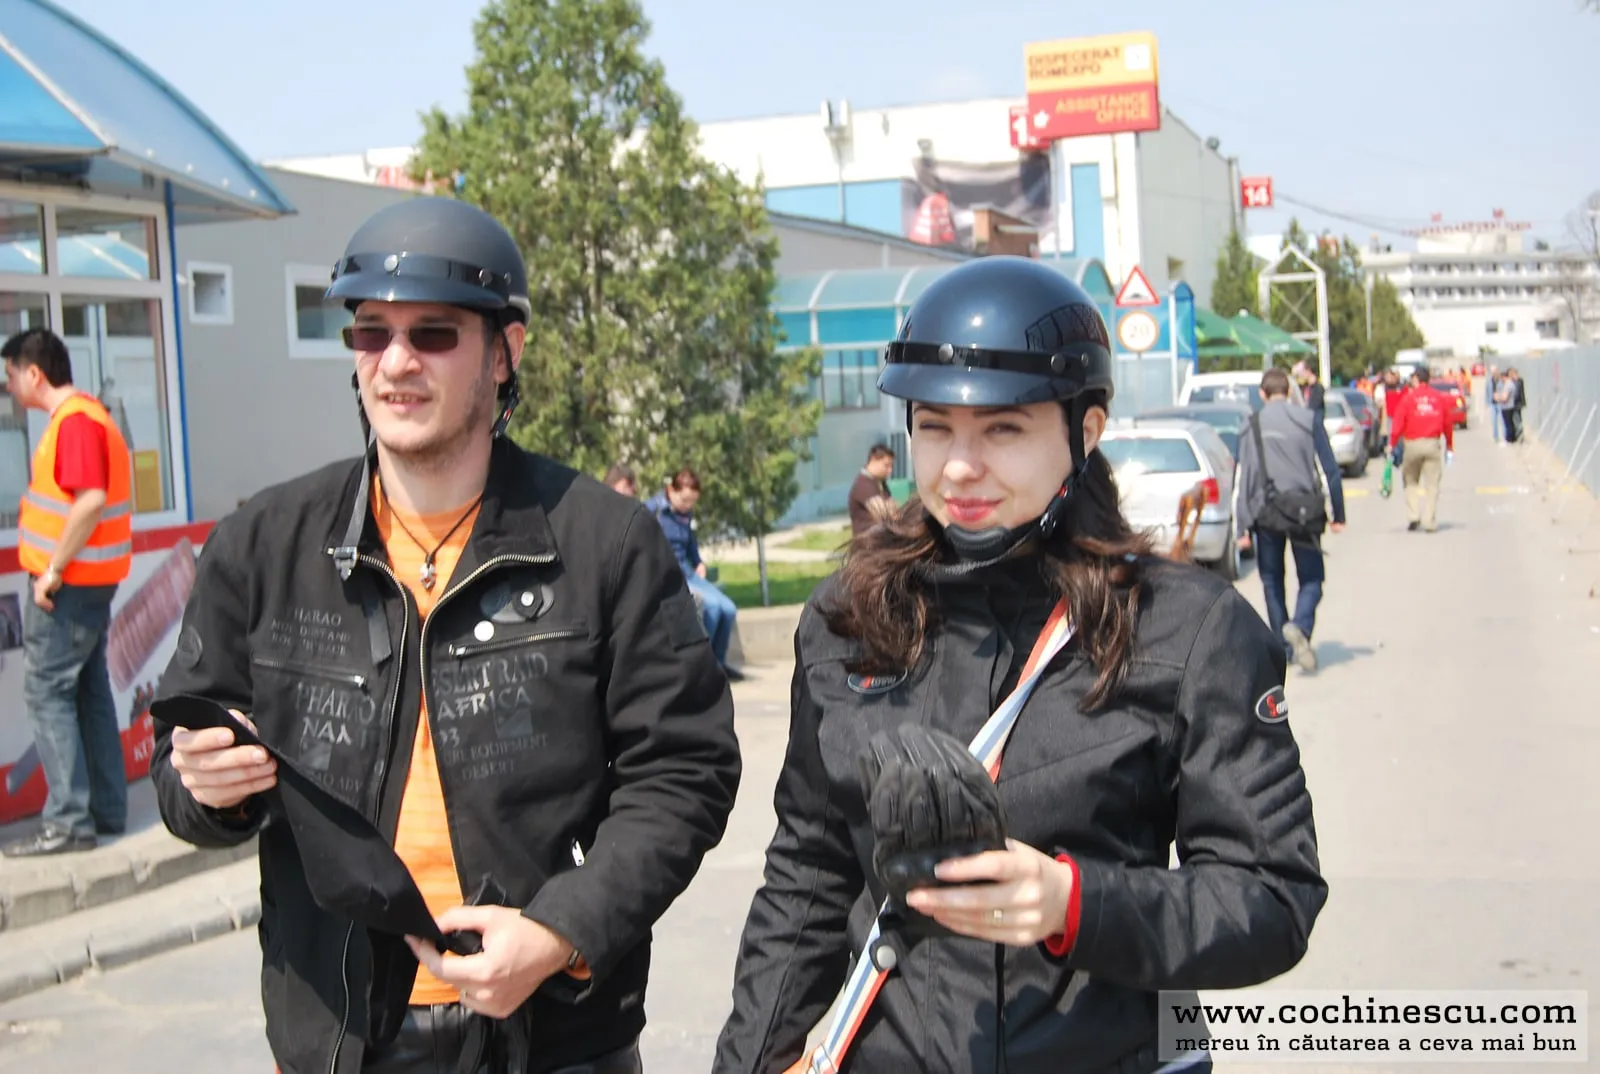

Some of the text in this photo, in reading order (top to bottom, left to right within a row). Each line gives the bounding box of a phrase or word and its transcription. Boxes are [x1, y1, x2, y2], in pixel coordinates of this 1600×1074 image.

[1028, 47, 1120, 66] DISPECERAT
[1029, 64, 1102, 80] ROMEXPO
[1055, 91, 1149, 114] ASSISTANCE
[1095, 106, 1149, 124] OFFICE
[1011, 115, 1037, 146] 1
[437, 685, 533, 723] AFRICA
